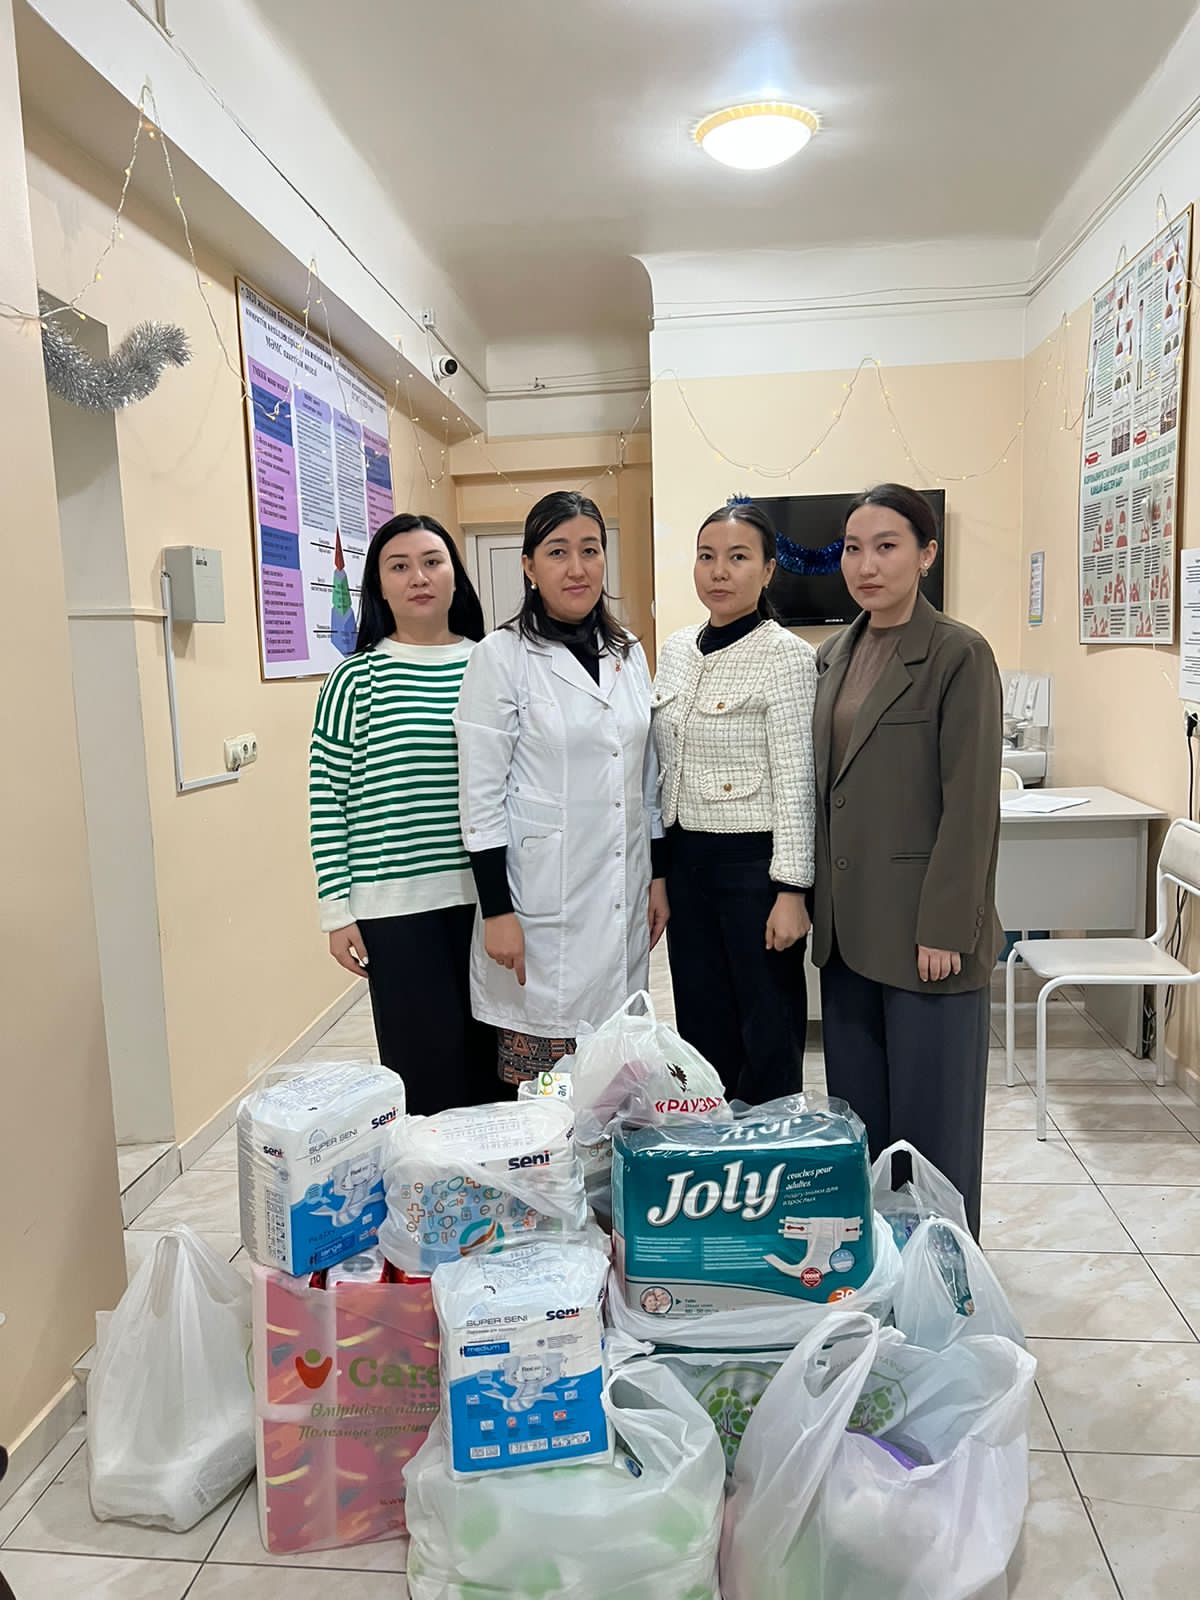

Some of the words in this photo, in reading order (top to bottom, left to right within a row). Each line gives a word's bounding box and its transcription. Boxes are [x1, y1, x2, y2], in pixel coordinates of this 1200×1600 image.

[371, 1106, 397, 1129] seni
[308, 1136, 338, 1156] SUPER
[339, 1129, 359, 1145] SENI
[263, 1145, 284, 1159] seni
[508, 1150, 550, 1171] seni
[815, 1166, 833, 1178] pour
[646, 1159, 787, 1227] Joly
[785, 1180, 811, 1191] adultes
[466, 1318, 502, 1328] SUPER
[504, 1314, 529, 1325] SENI
[546, 1306, 580, 1321] seni
